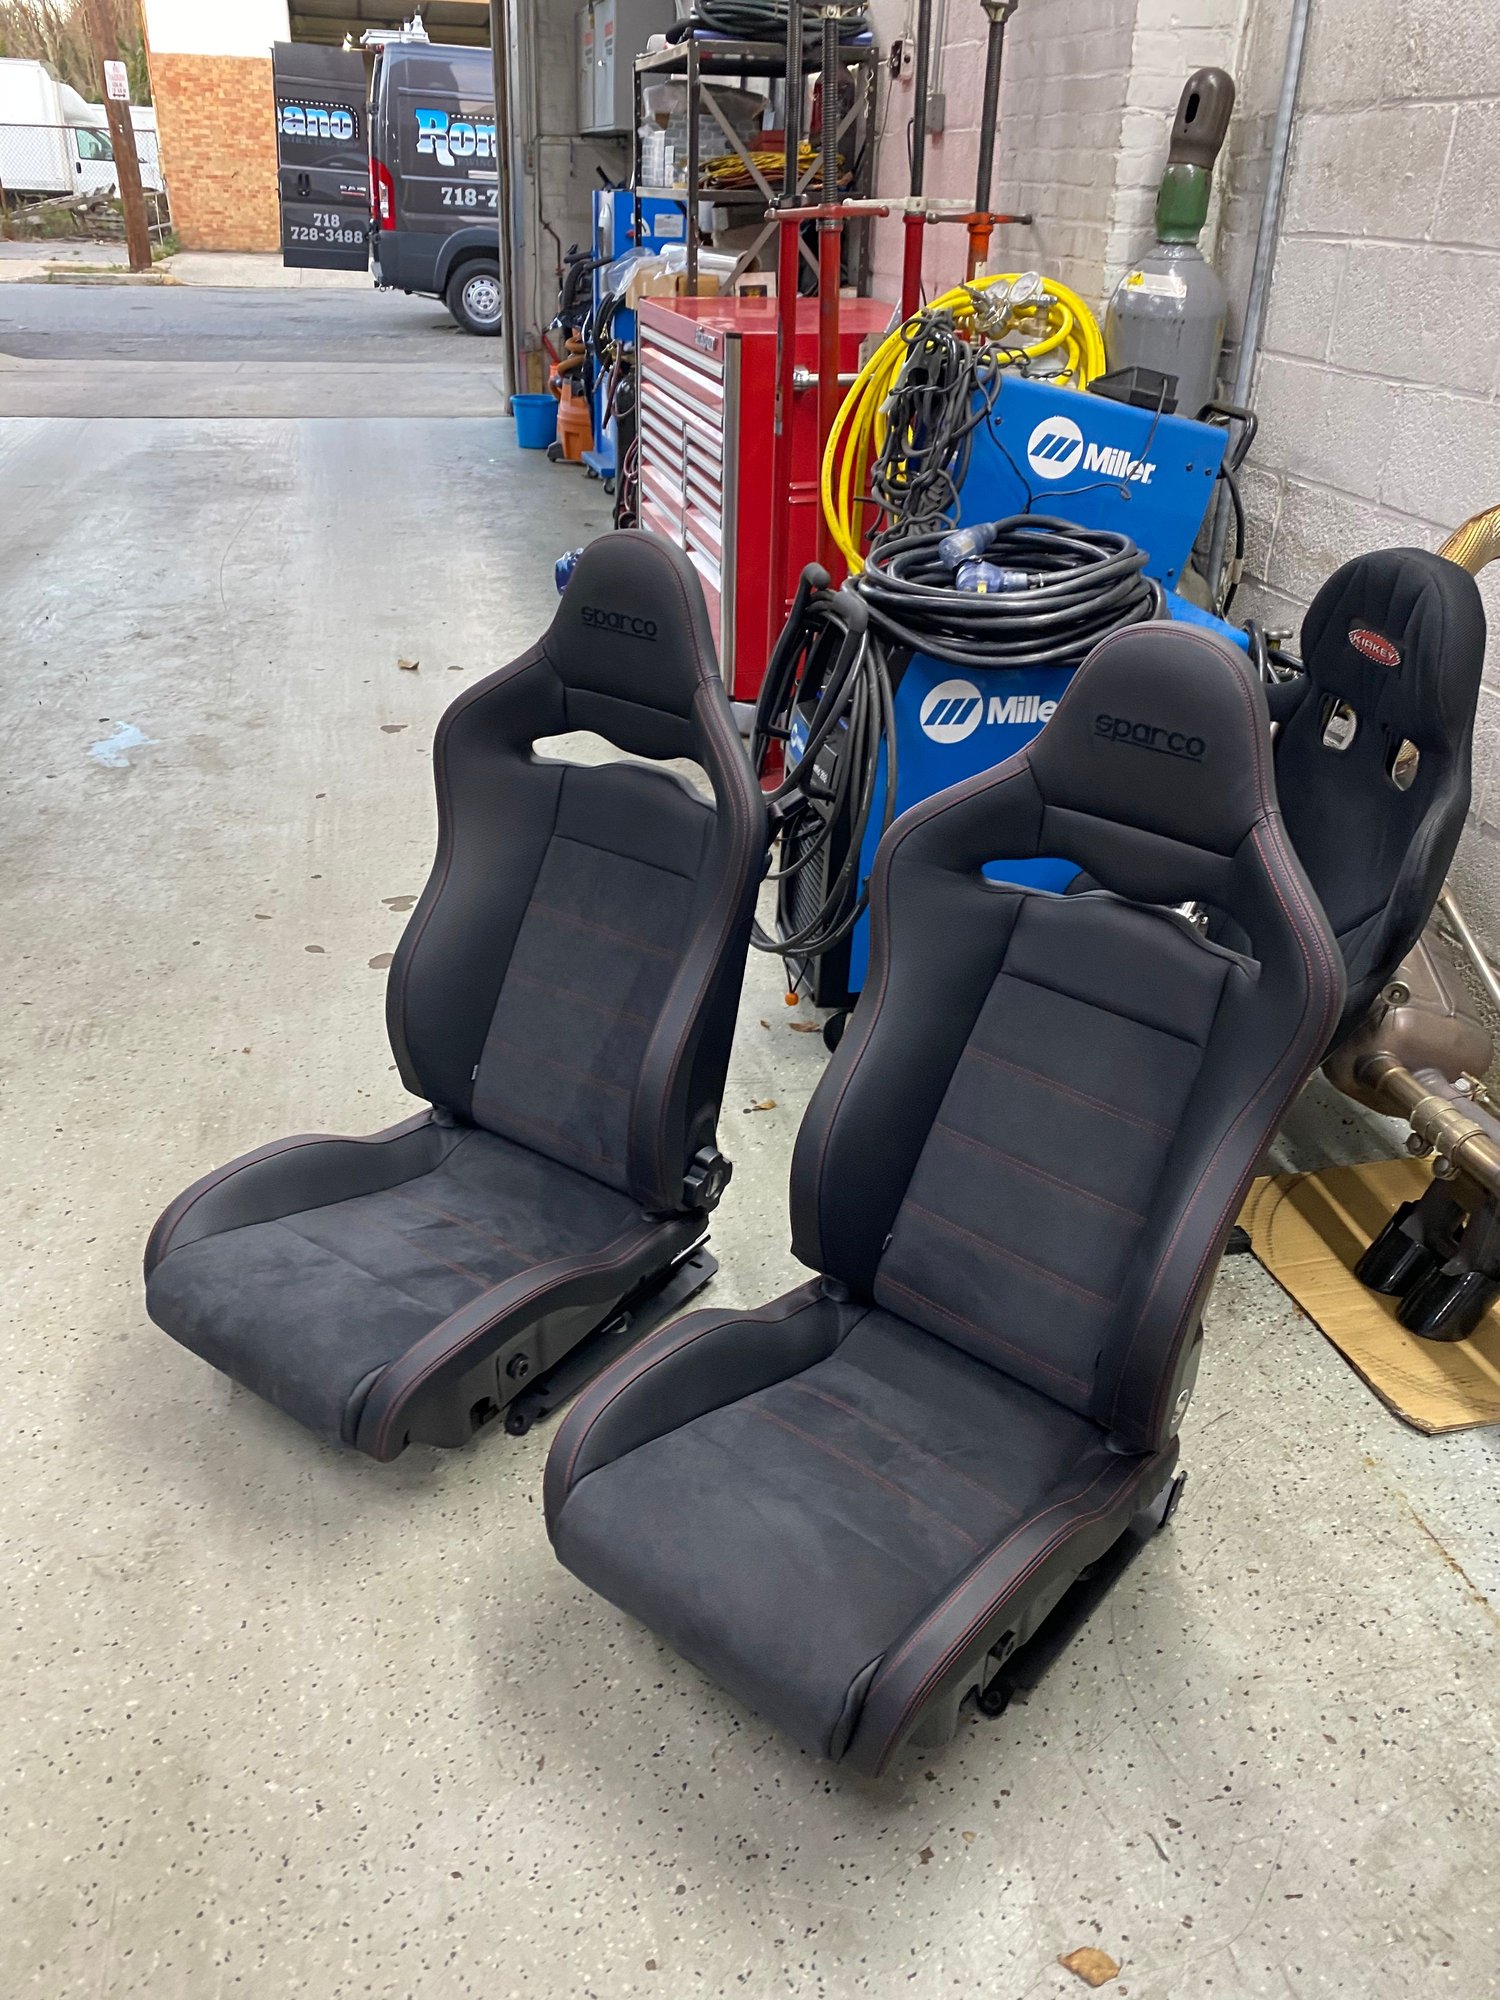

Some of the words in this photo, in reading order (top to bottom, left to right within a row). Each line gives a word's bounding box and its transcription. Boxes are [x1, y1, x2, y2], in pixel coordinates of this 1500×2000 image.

[313, 213, 340, 228] 718
[290, 226, 363, 244] 728-3488
[1083, 443, 1156, 484] Miller
[581, 606, 657, 636] sparco
[1352, 634, 1395, 661] KIRKEY
[1095, 714, 1206, 756] sparco
